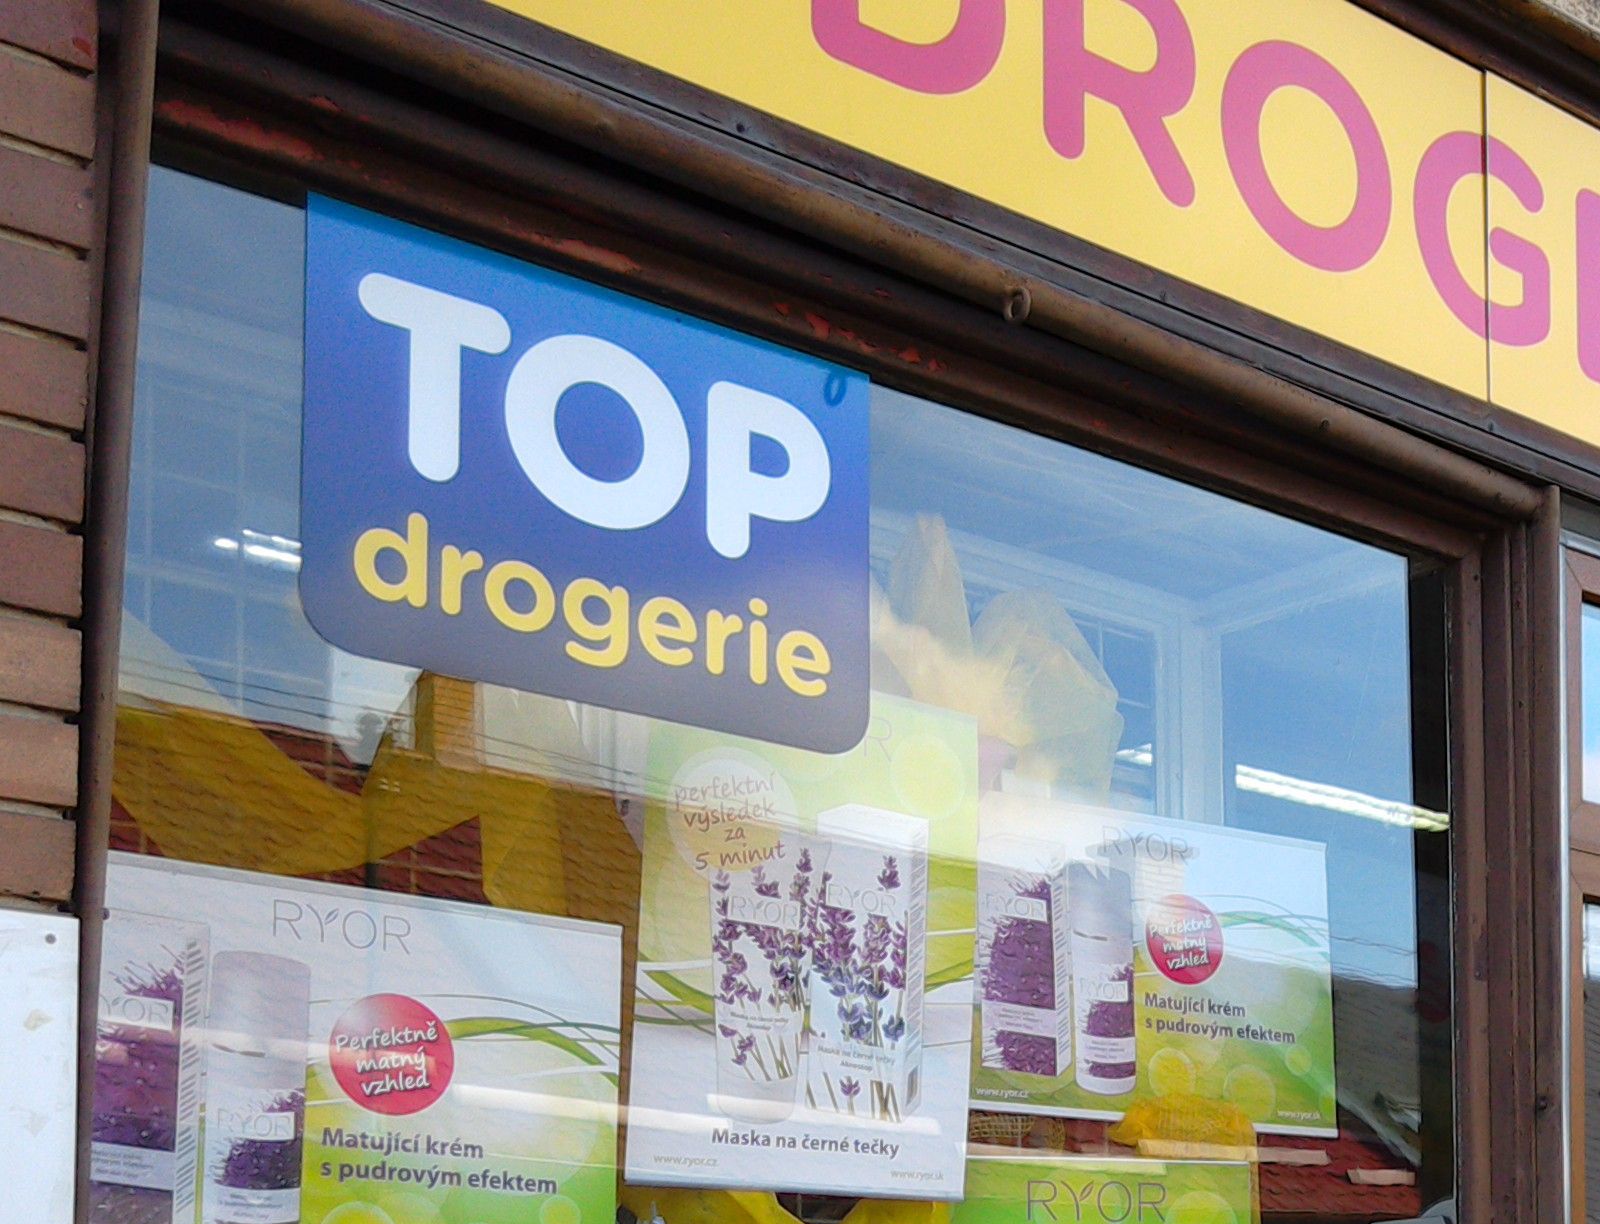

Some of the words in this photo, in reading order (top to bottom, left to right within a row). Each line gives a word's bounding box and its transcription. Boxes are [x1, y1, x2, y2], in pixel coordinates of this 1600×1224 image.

[358, 272, 832, 561] TOP
[352, 512, 832, 698] drogerie
[674, 772, 776, 810] perfektní
[684, 799, 777, 832] výsledek
[724, 827, 746, 843] za
[1101, 825, 1190, 866] RYOR
[695, 851, 710, 871] 5
[719, 839, 787, 867] minut
[729, 894, 800, 926] RYOR
[827, 882, 898, 918] RYOR
[272, 898, 411, 955] RYOR
[1166, 949, 1210, 971] vzhled
[99, 992, 169, 1024] YOR
[1144, 991, 1205, 1017] Matující
[1207, 999, 1246, 1018] krém
[335, 1021, 439, 1053] Perfektně
[1144, 1017, 1153, 1028] s
[1156, 1016, 1233, 1041] pudrovým
[1236, 1025, 1296, 1044] efektem
[355, 1046, 426, 1078] matný
[361, 1070, 430, 1097] vzhled
[217, 1108, 292, 1138] RYOR
[321, 1127, 419, 1157] Matující
[425, 1135, 485, 1160] krém
[711, 1128, 772, 1148] Maska
[775, 1135, 797, 1149] na
[801, 1134, 849, 1153] černé
[853, 1138, 899, 1160] tečky
[320, 1160, 332, 1177] s
[338, 1160, 462, 1190] pudrovým
[467, 1169, 558, 1195] efektem
[1027, 1179, 1168, 1223] RYOR
